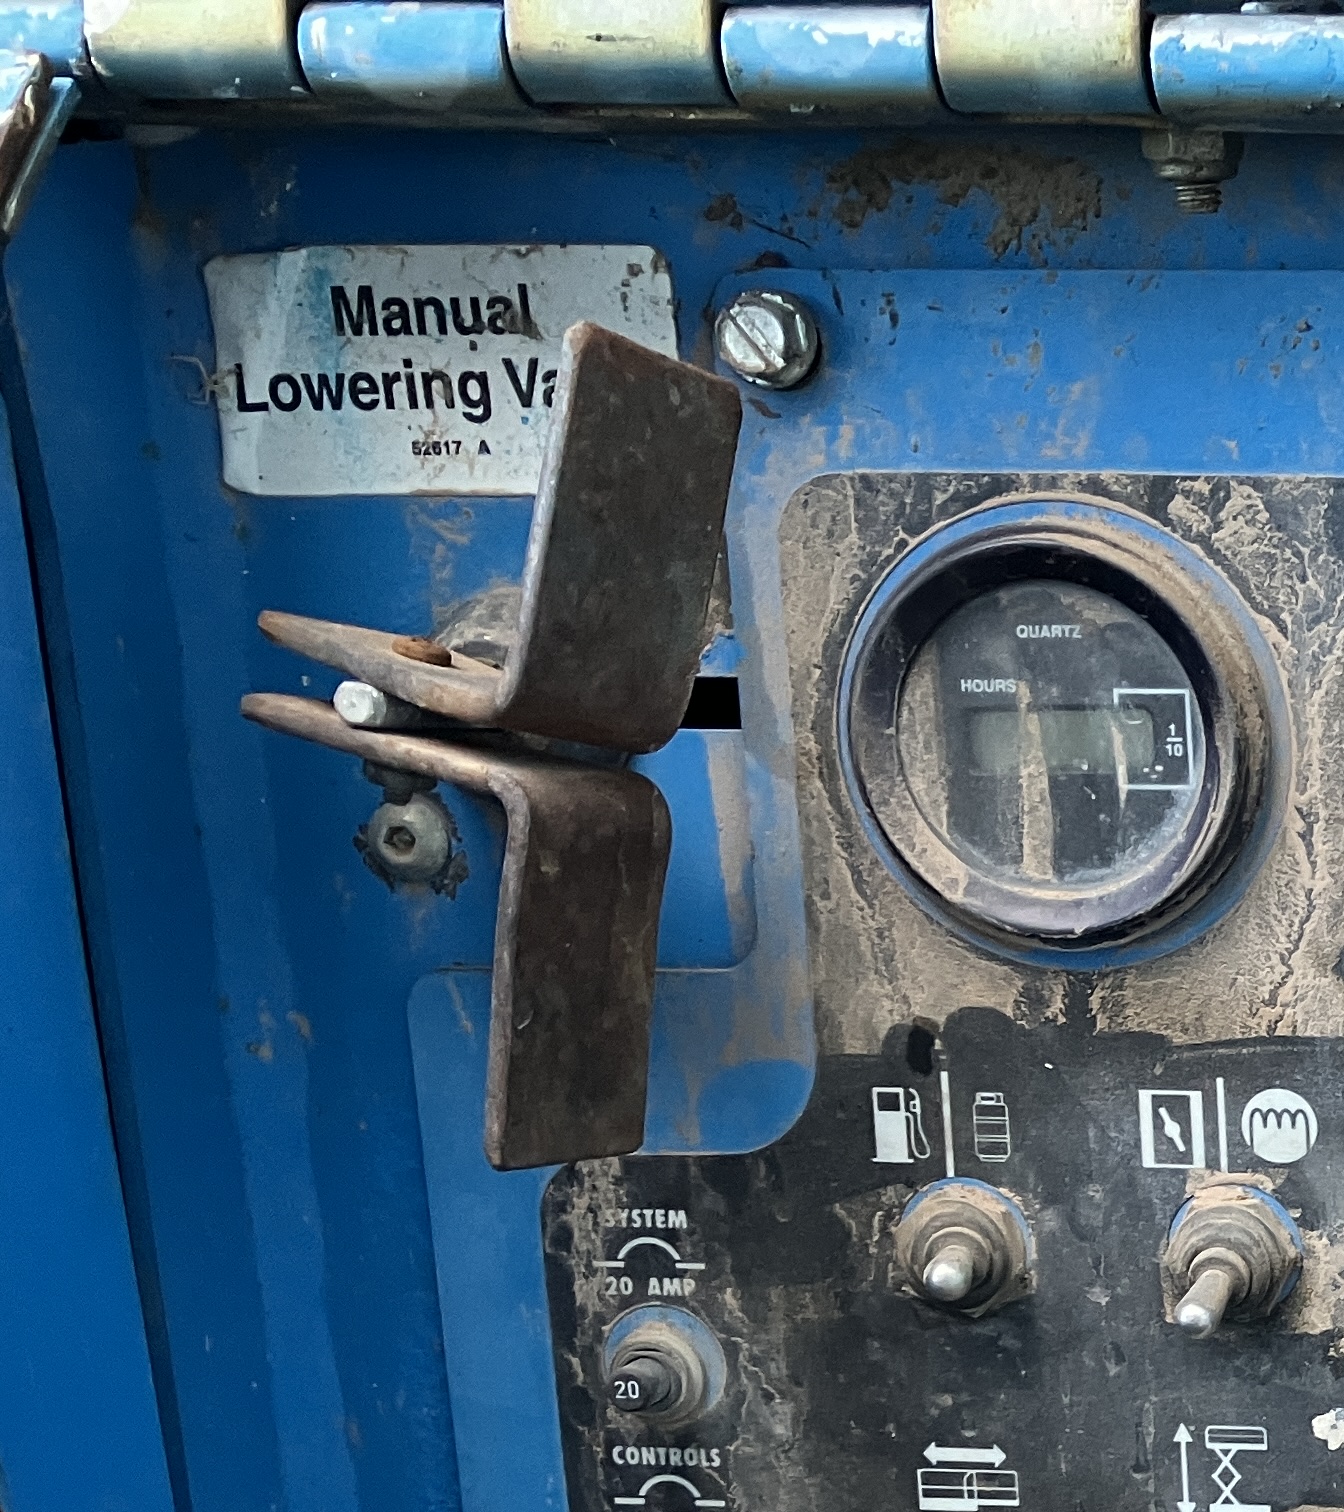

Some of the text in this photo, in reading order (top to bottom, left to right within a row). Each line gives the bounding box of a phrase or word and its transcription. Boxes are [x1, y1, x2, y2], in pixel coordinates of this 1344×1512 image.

[329, 282, 532, 336] Manual
[235, 358, 492, 423] Lowering
[477, 439, 492, 456] A
[1016, 624, 1082, 639] QUARTZ
[960, 678, 1017, 693] HOURS
[1165, 743, 1184, 757] 10
[603, 1208, 688, 1231] SYSTEM
[604, 1276, 696, 1298] 20 AMP
[613, 1380, 640, 1400] 20
[611, 1446, 722, 1469] CONTROLS
